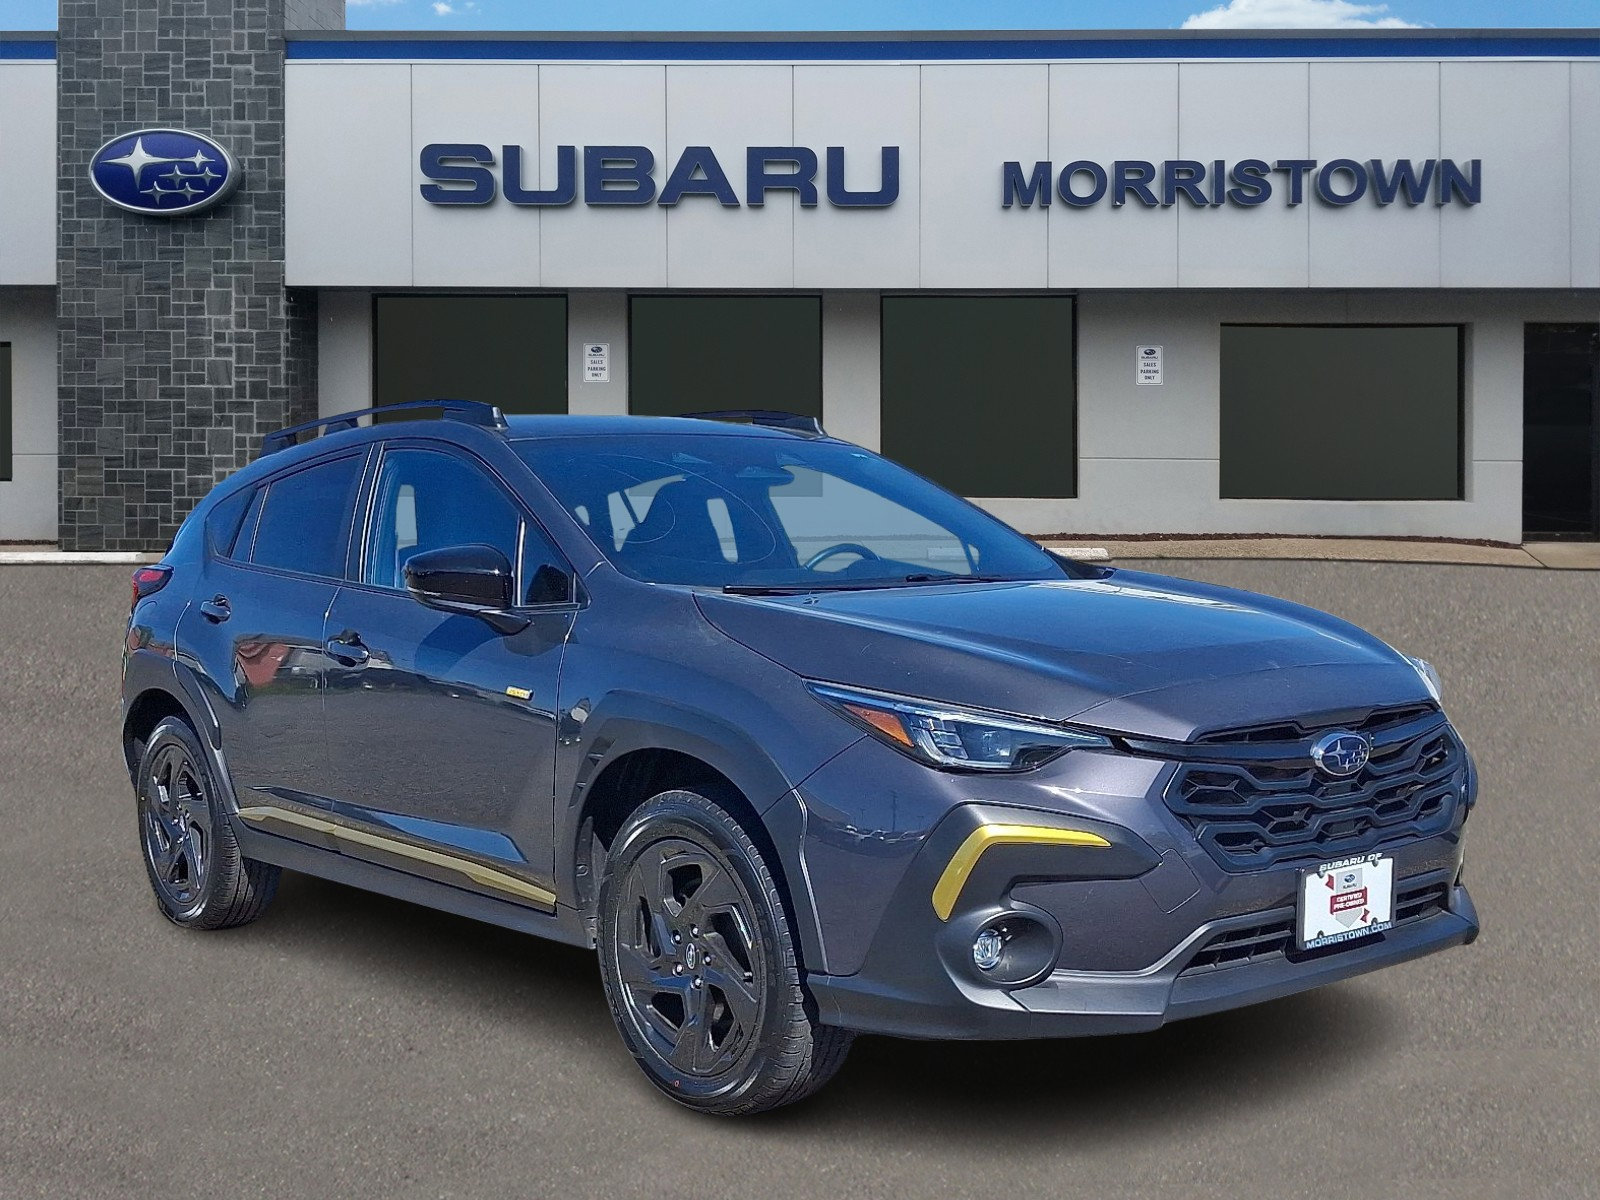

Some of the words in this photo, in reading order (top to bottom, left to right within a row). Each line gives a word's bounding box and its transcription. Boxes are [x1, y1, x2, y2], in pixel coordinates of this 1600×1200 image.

[420, 143, 899, 207] SUBARU
[1001, 158, 1482, 208] MORRISTOWN
[1319, 855, 1365, 872] SUBARU
[1367, 852, 1383, 862] OF
[1306, 921, 1392, 950] MORRISTOWN.COM
